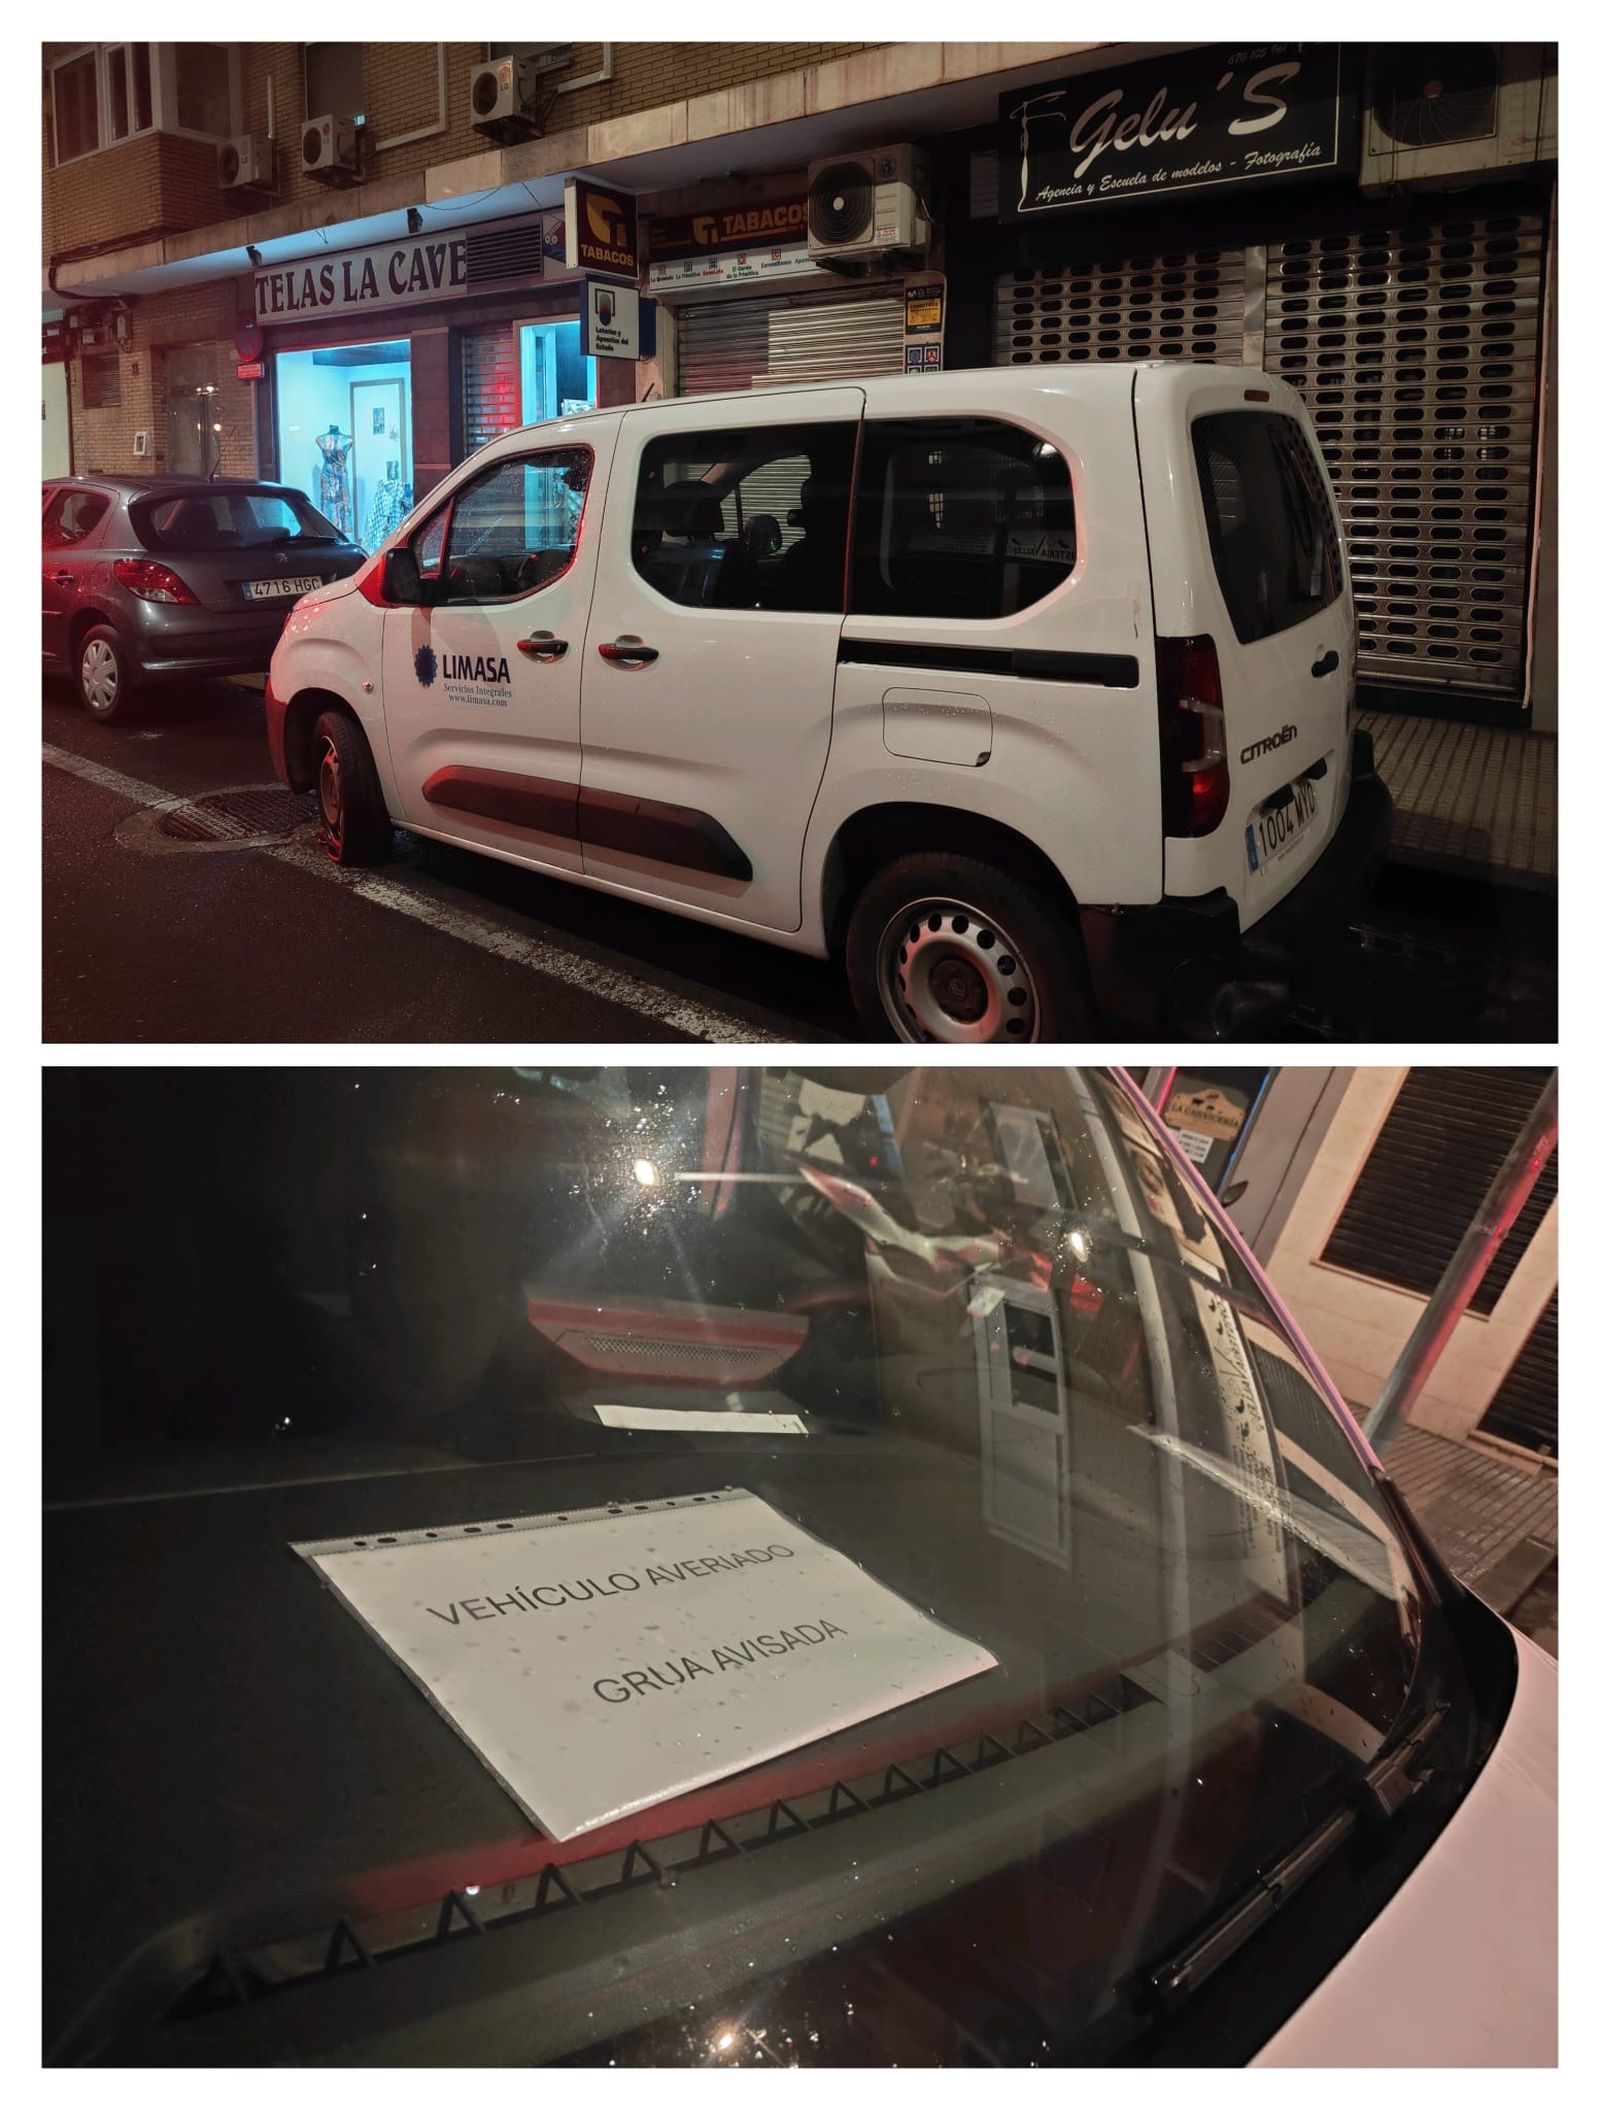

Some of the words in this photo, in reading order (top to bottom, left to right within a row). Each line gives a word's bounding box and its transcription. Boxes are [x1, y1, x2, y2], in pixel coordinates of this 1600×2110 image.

[1035, 183, 1083, 201] Agencia
[1086, 183, 1095, 195] y
[1099, 173, 1148, 192] Escuela
[1152, 169, 1167, 182] de
[1171, 160, 1222, 180] modelos
[1244, 142, 1322, 170] Fotografía
[580, 243, 634, 267] TABACOS
[255, 264, 336, 315] TELAS
[342, 257, 380, 302] LA
[388, 239, 466, 295] CAVE
[254, 580, 291, 596] 4716
[293, 578, 320, 592] HGC
[442, 654, 511, 684] LIMASA
[443, 683, 474, 694] Servicios
[476, 685, 512, 698] Integrales
[448, 694, 508, 707] www.limasa.com
[1258, 805, 1294, 857] 1004
[425, 1571, 641, 1628] VEHÍCULO
[646, 1543, 796, 1589] AVERIADO
[592, 1655, 712, 1705] GRUA
[710, 1615, 850, 1673] AVISADA
